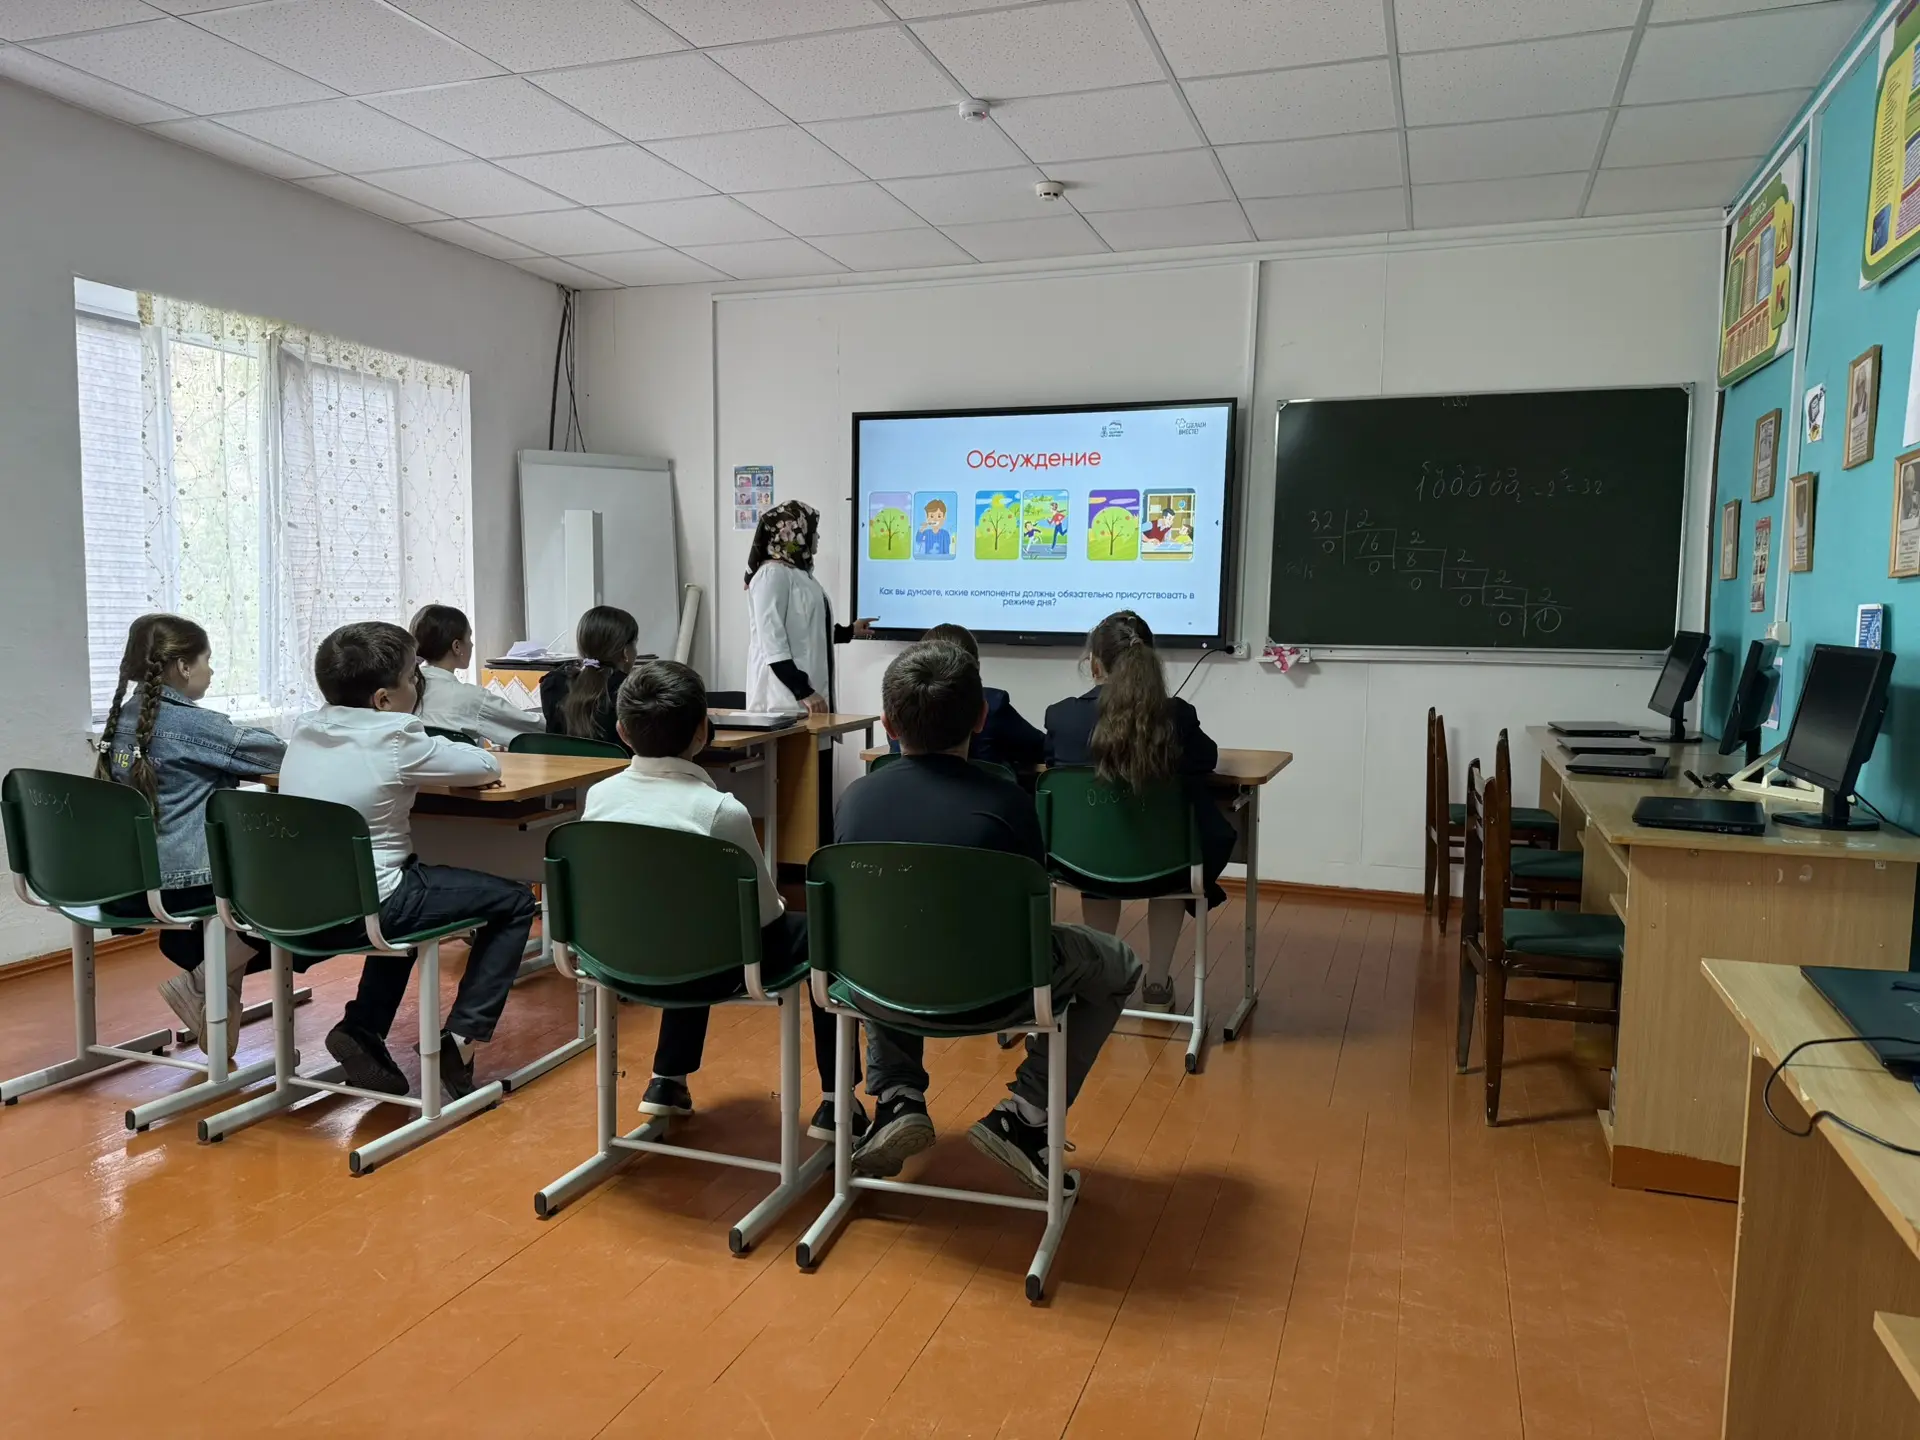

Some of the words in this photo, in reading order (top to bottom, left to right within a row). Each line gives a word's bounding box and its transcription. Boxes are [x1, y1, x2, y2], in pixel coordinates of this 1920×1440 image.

[966, 449, 1102, 473] Обсуждение
[1308, 509, 1334, 533] 32
[879, 586, 894, 596] Как
[895, 588, 906, 596] вы
[907, 588, 943, 597] думаете,
[944, 588, 969, 597] какие
[970, 589, 1021, 598] компоненты
[1022, 589, 1056, 599] должны
[1057, 589, 1114, 599] обязательно
[1115, 591, 1188, 601] присутствовать
[1189, 591, 1196, 600] в
[1002, 598, 1036, 607] режиме
[1036, 598, 1057, 607] дня?
